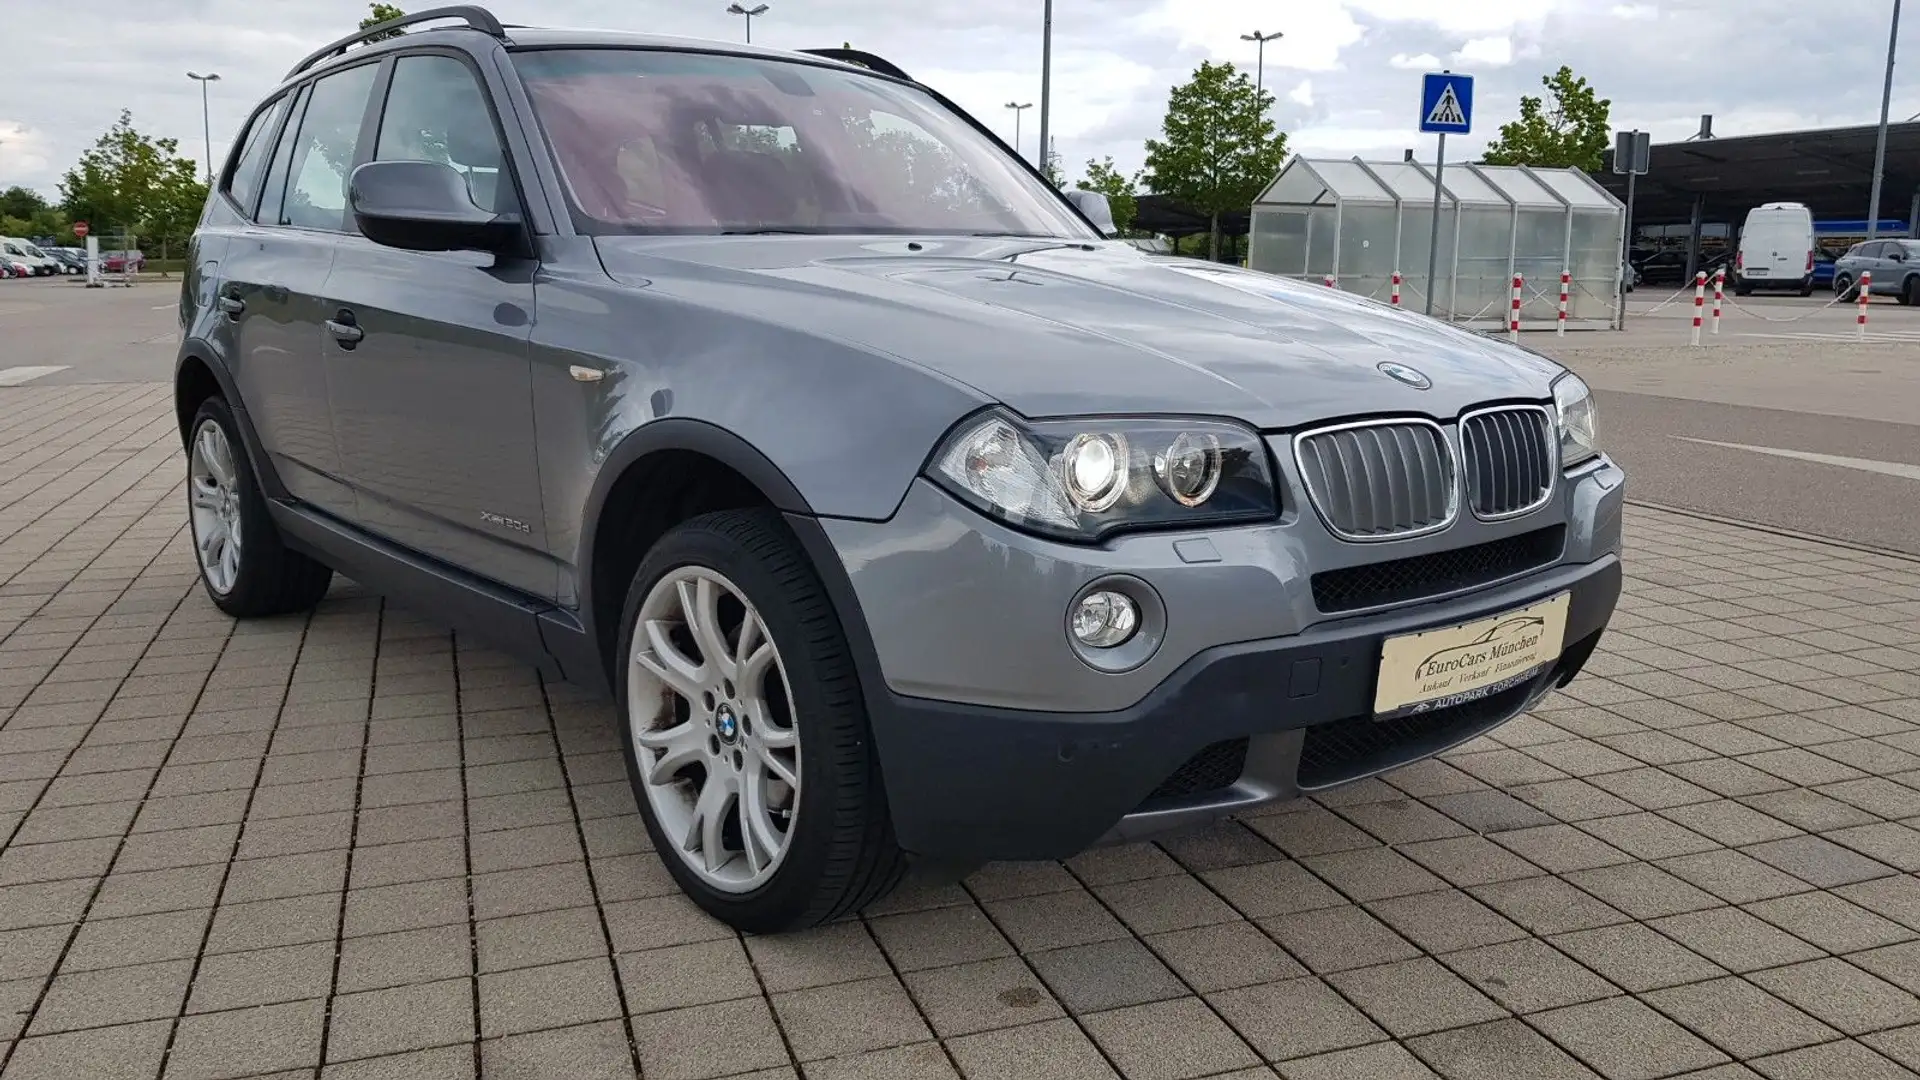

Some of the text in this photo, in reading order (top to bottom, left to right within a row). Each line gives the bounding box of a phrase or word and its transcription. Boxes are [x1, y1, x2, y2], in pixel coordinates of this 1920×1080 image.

[1425, 635, 1539, 677] EuroCars München
[1459, 667, 1491, 684] Verkauf
[1434, 687, 1489, 711] AUTOPARK
